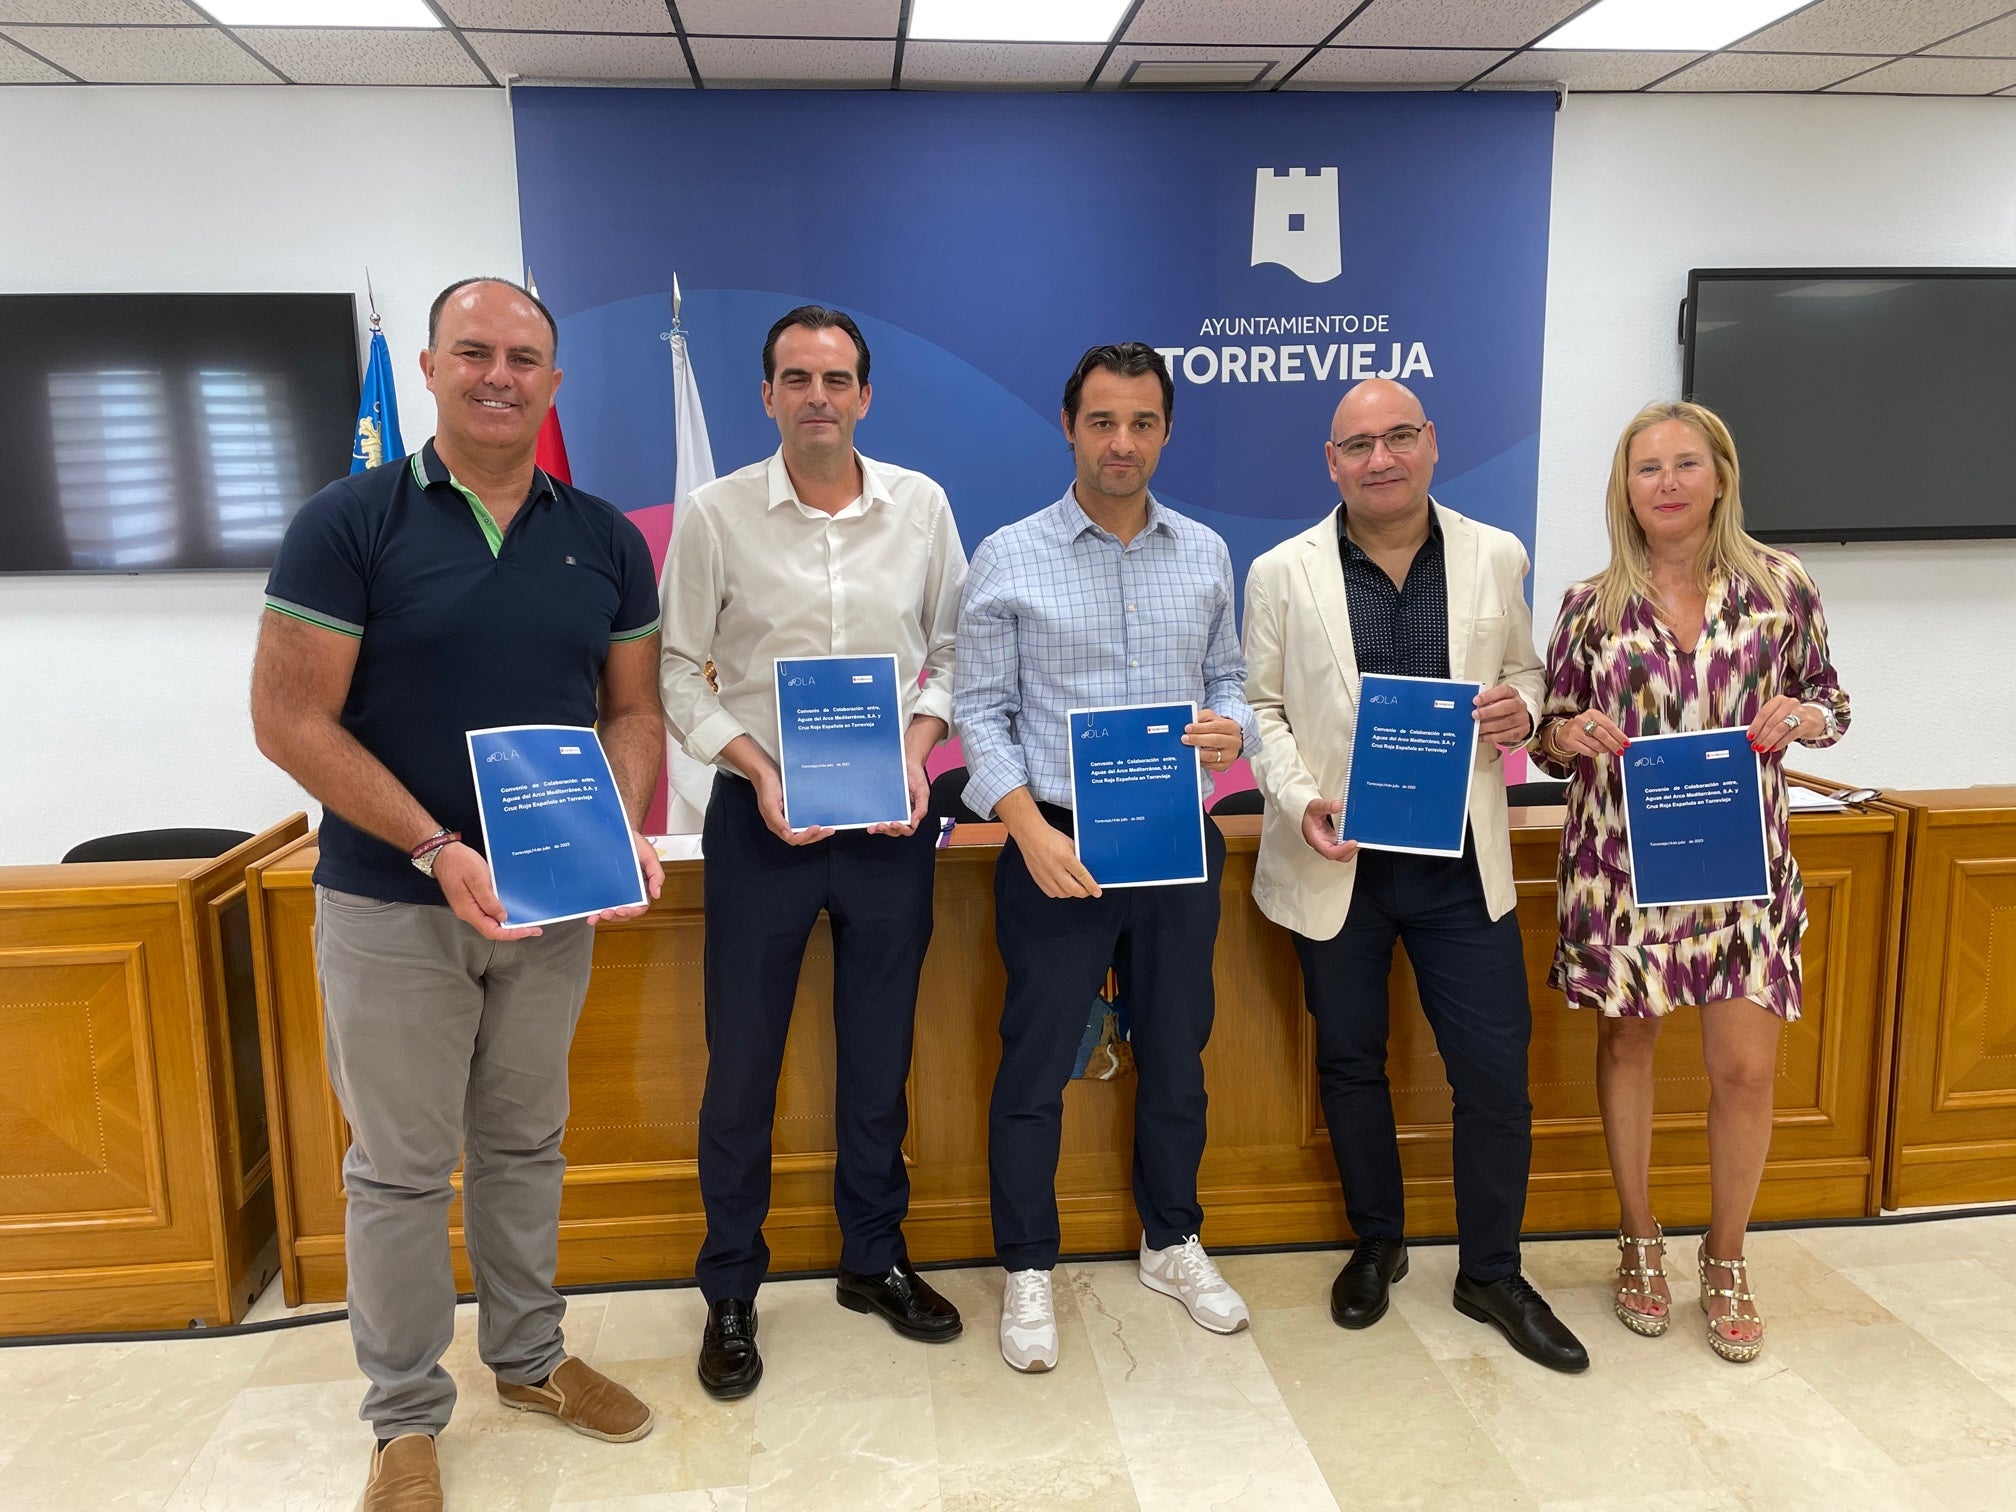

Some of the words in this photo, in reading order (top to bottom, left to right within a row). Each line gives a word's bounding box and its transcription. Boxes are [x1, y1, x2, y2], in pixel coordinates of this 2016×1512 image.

[1200, 316, 1359, 336] AYUNTAMIENTO
[1363, 314, 1390, 333] DE
[1154, 341, 1434, 385] TORREVIEJA
[501, 785, 527, 793] Convenio
[544, 779, 578, 787] Colaboración
[533, 799, 558, 807] Española
